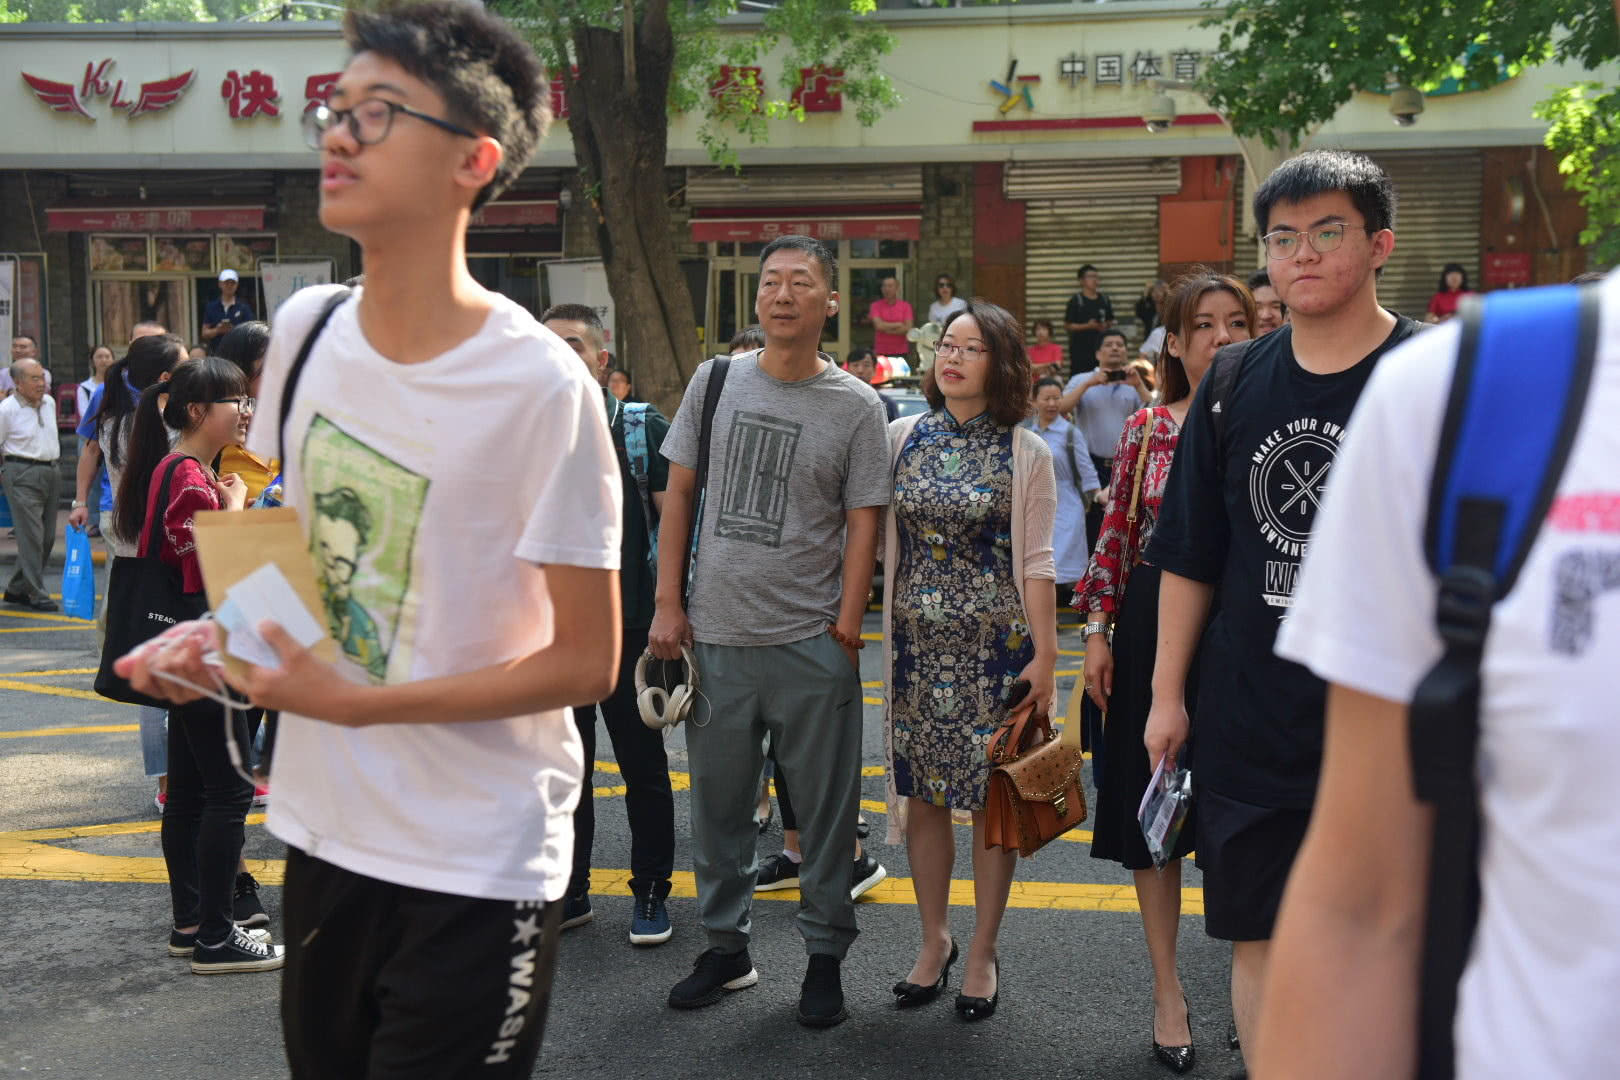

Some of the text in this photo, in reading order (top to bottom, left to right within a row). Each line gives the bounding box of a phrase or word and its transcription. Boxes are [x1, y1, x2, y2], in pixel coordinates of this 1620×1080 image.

[1059, 49, 1229, 88] 中国体育
[1252, 417, 1347, 464] MAKE YOUR OWN
[485, 949, 537, 1064] WASH
